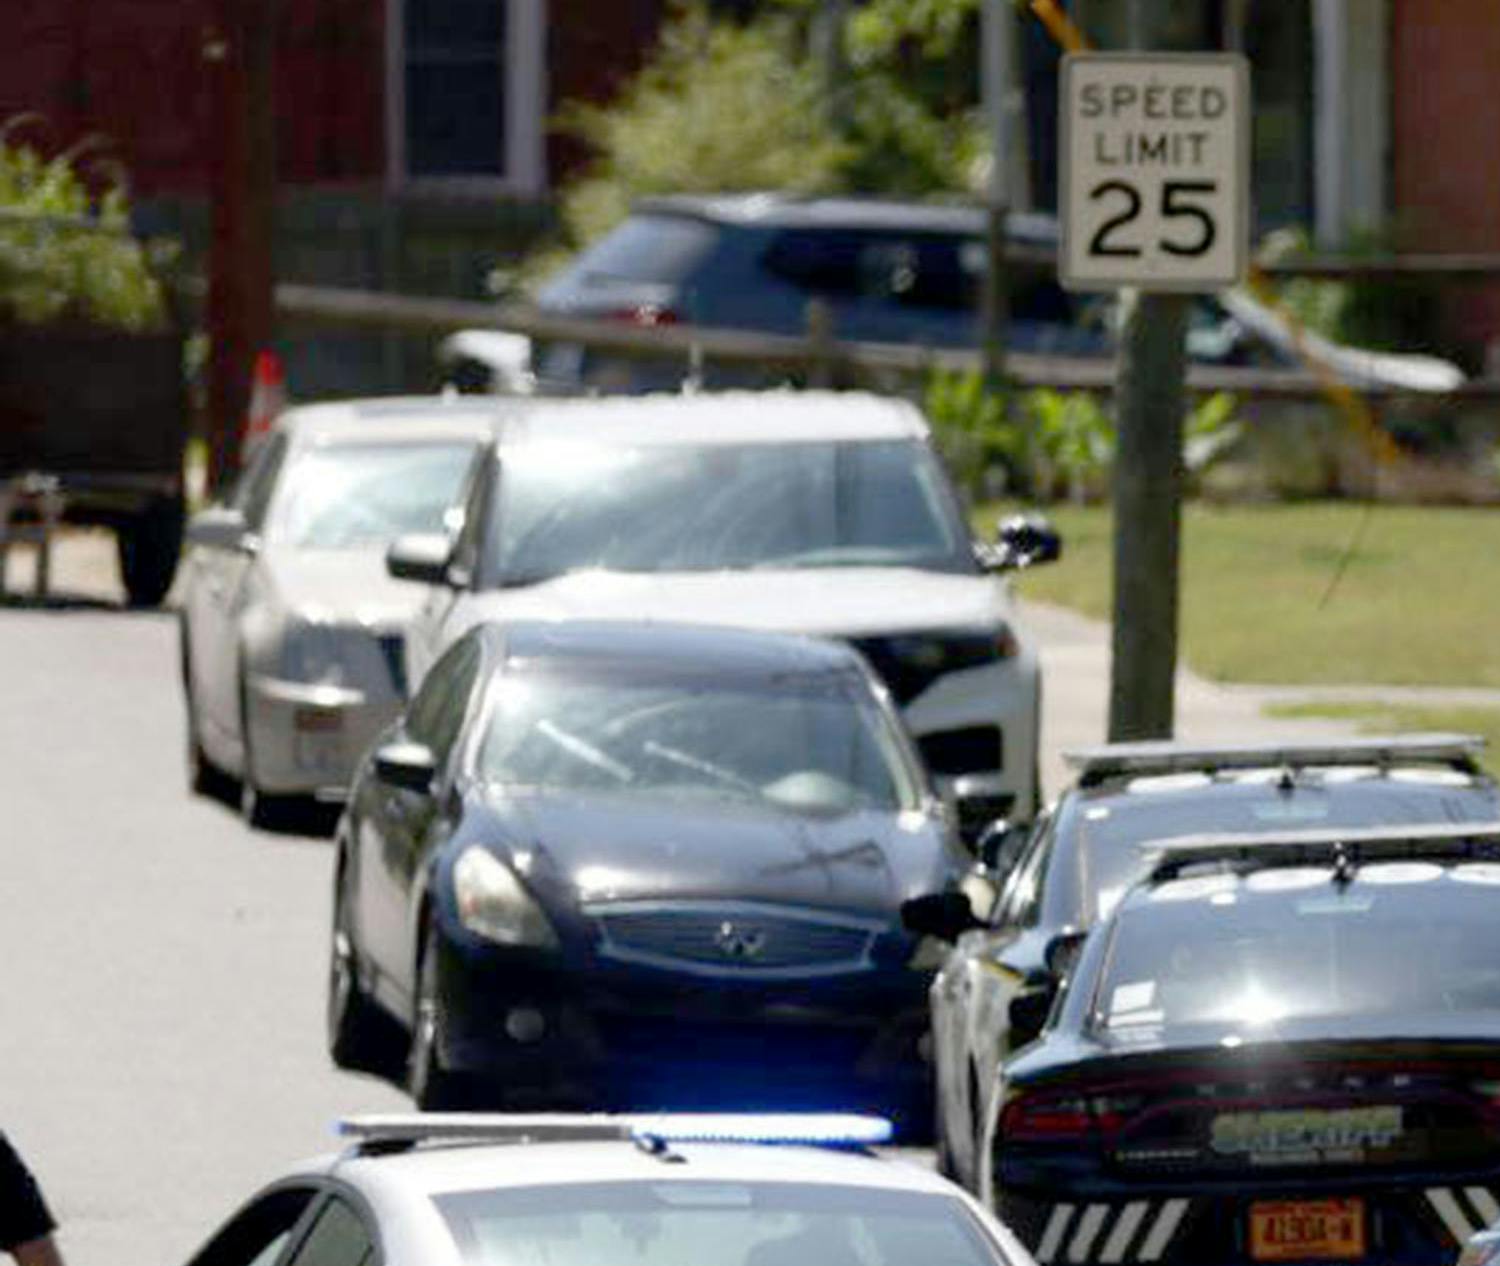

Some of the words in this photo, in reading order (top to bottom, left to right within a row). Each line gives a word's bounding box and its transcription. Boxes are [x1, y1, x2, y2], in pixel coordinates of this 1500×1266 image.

[1080, 84, 1227, 119] SPEED
[1095, 133, 1211, 165] LIMIT
[1088, 181, 1217, 257] 25
